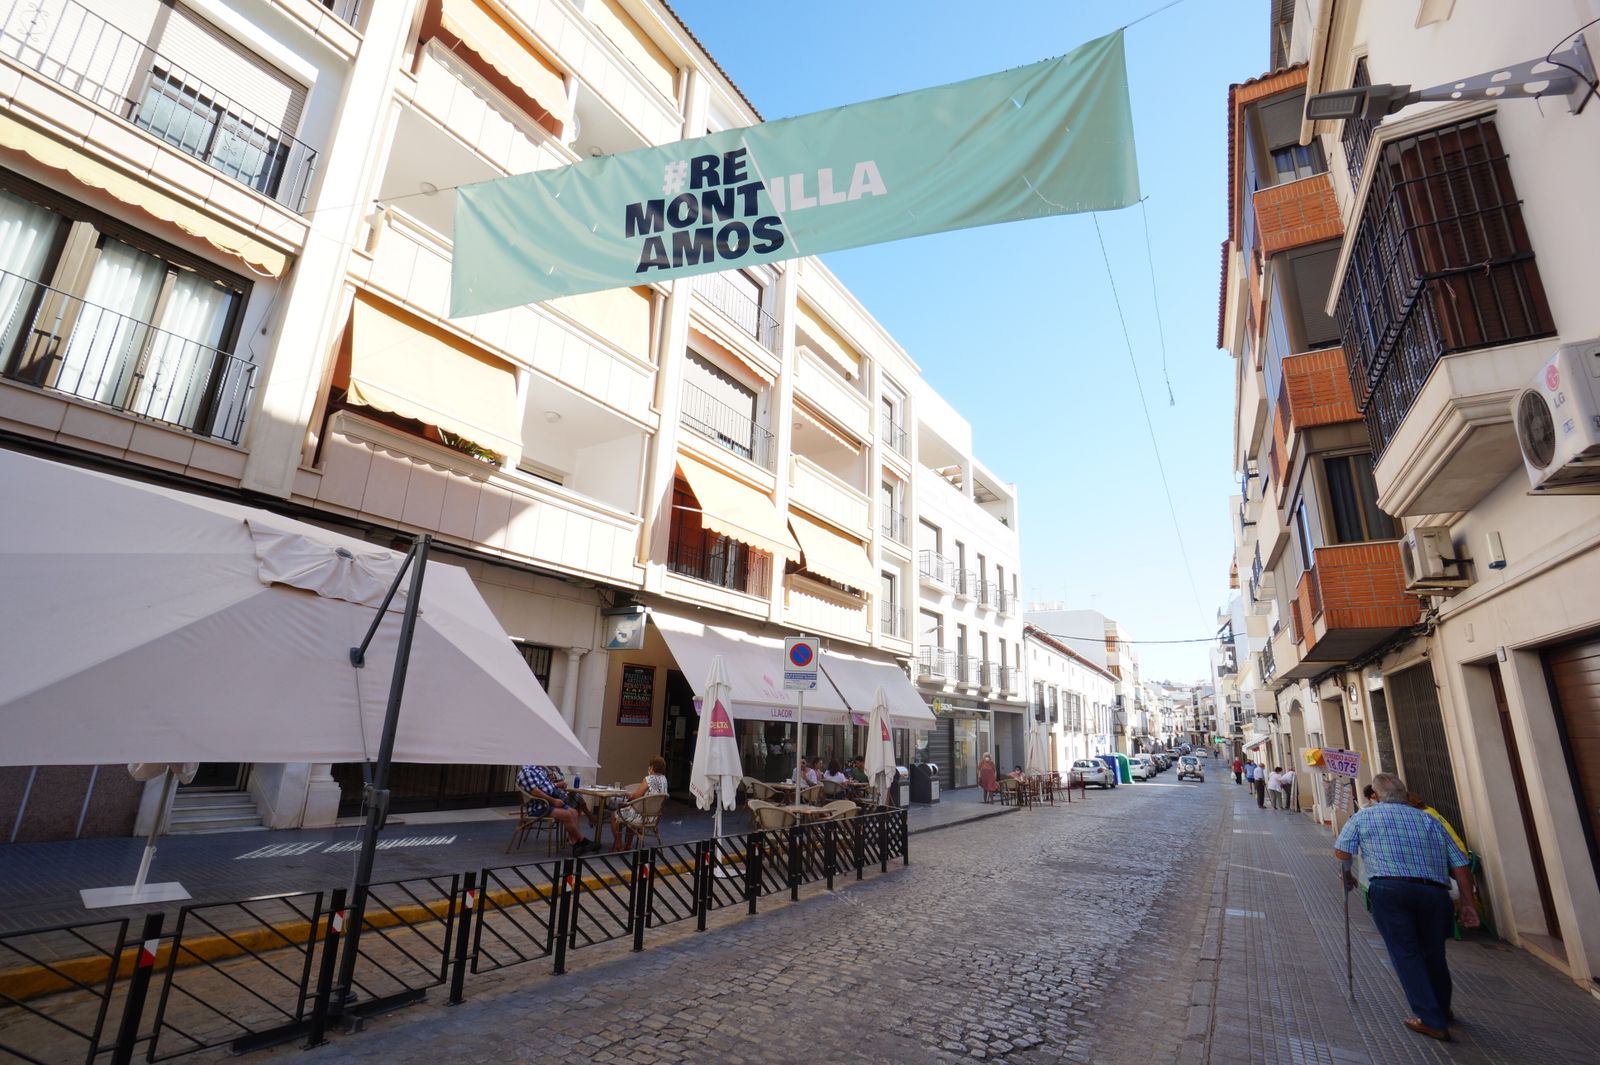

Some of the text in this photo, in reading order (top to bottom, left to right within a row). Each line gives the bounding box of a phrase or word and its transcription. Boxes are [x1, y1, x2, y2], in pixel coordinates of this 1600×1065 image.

[662, 147, 748, 195] #RE
[635, 215, 785, 274] AMOS
[1553, 392, 1566, 409] LG
[1326, 758, 1357, 774] 18.075
